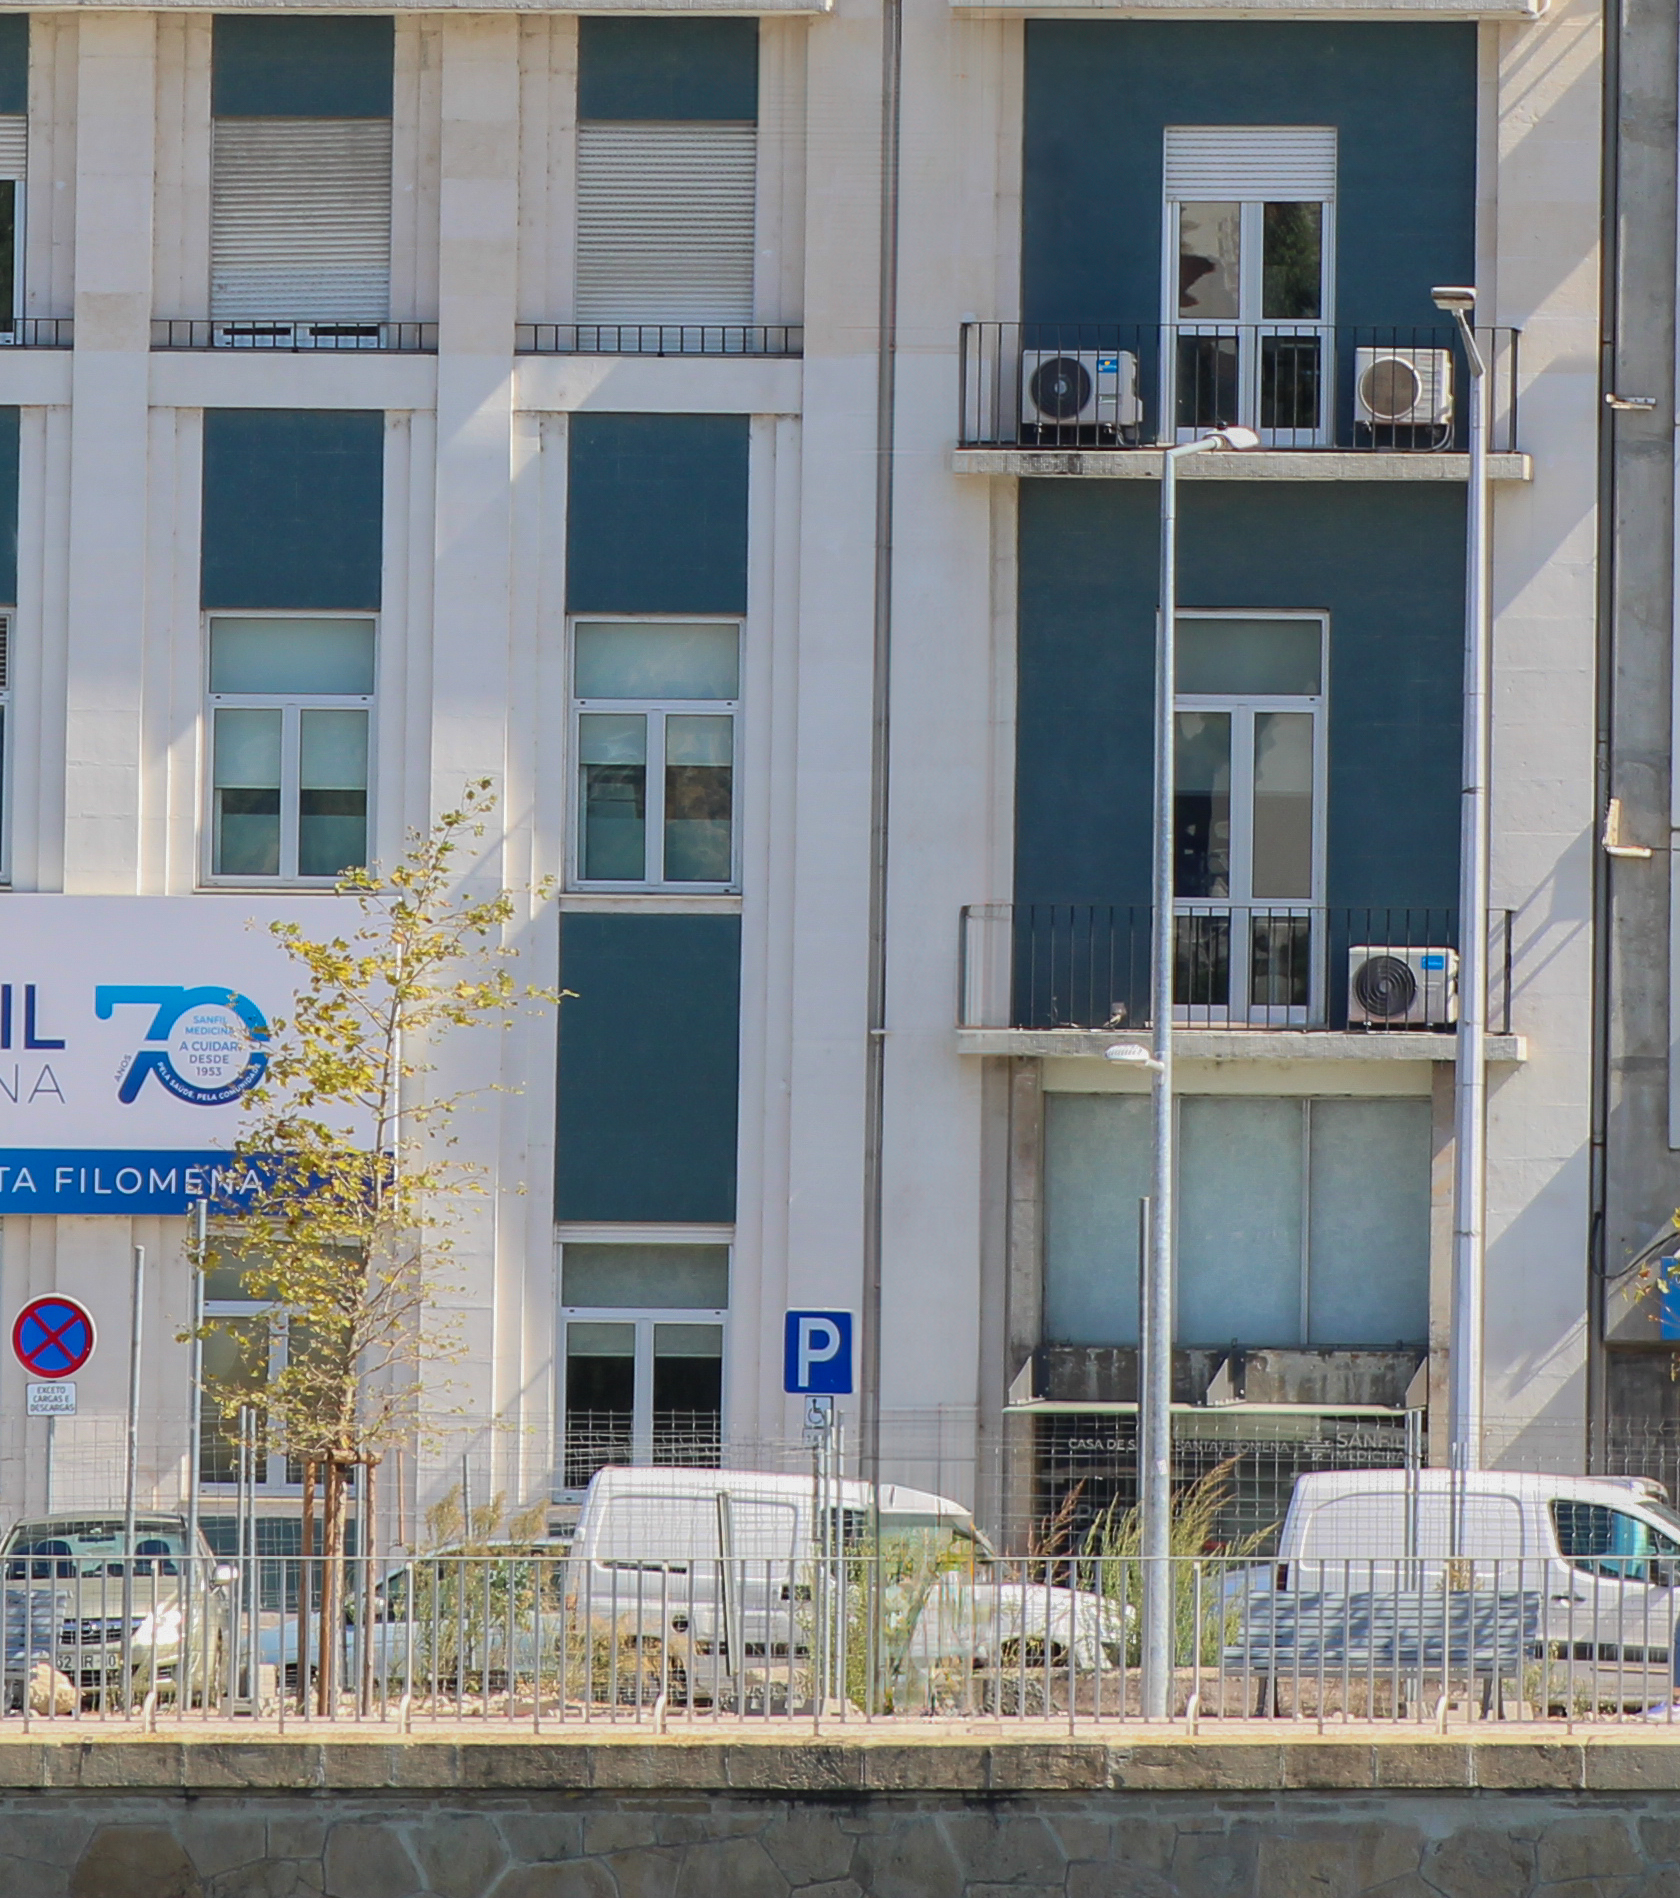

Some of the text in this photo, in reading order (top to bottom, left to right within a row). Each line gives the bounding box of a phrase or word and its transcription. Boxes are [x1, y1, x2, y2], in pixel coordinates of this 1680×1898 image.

[193, 1015, 227, 1024] SANFIL
[95, 985, 270, 1105] 70
[179, 1041, 238, 1052] A CUIDAR
[189, 1054, 229, 1064] DESDE
[114, 1053, 132, 1083] ANOS
[196, 1066, 222, 1076] 1953
[196, 1093, 218, 1101] PELA
[55, 1167, 264, 1196] FILOMENA
[798, 1317, 840, 1388] P
[37, 1386, 66, 1394] EXCETO
[33, 1394, 63, 1403] CARGAS
[30, 1403, 75, 1412] DESCARGAS
[1068, 1439, 1104, 1451] CASA
[1107, 1439, 1125, 1450] DE
[1337, 1432, 1404, 1448] SANFIL
